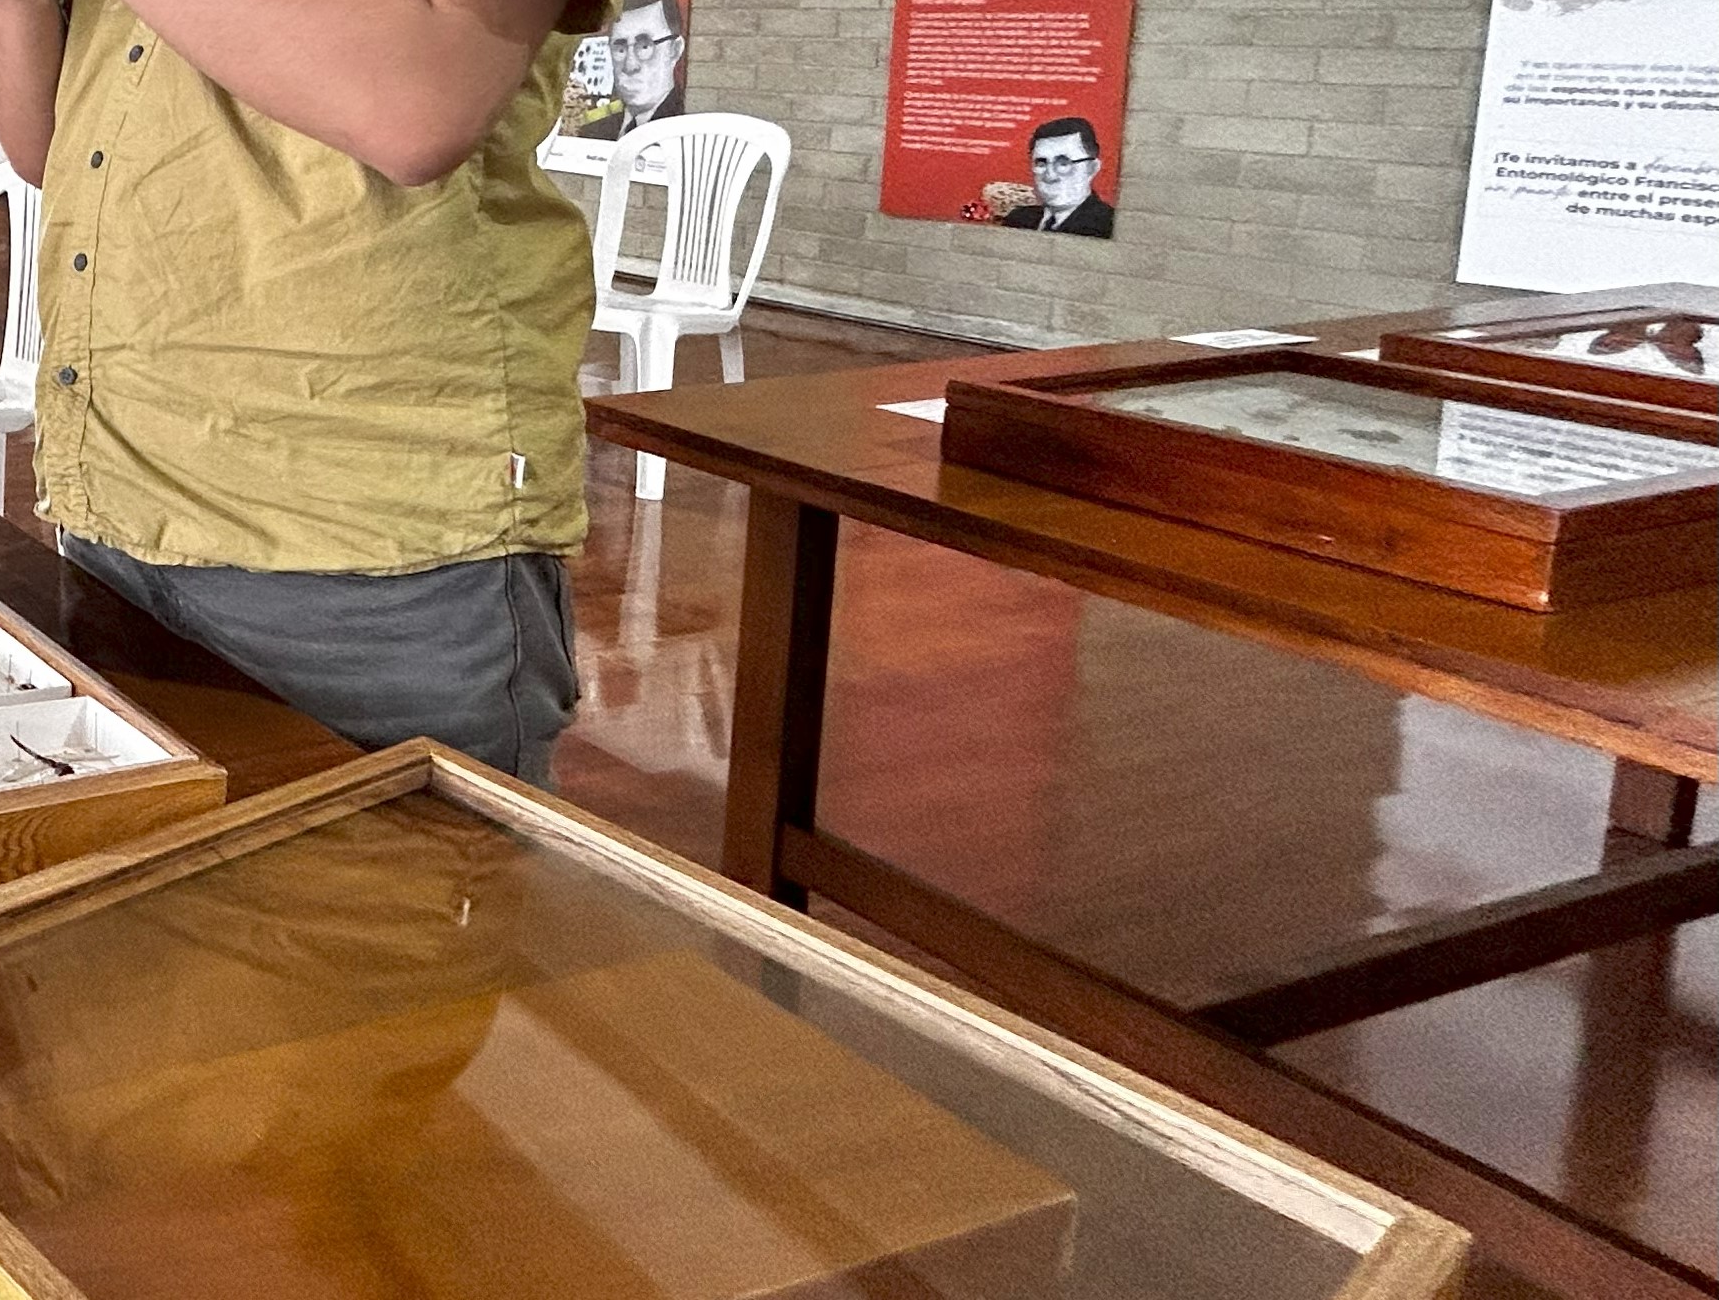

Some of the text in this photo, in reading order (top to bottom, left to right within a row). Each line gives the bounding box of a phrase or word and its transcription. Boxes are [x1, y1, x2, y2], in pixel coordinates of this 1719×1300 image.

[1525, 153, 1620, 170] invitamos
[1624, 161, 1637, 170] a
[1495, 166, 1629, 186] Entomológico
[1578, 190, 1630, 201] entre
[1635, 191, 1654, 203] el
[1565, 203, 1590, 214] de
[1595, 206, 1675, 222] muchas
